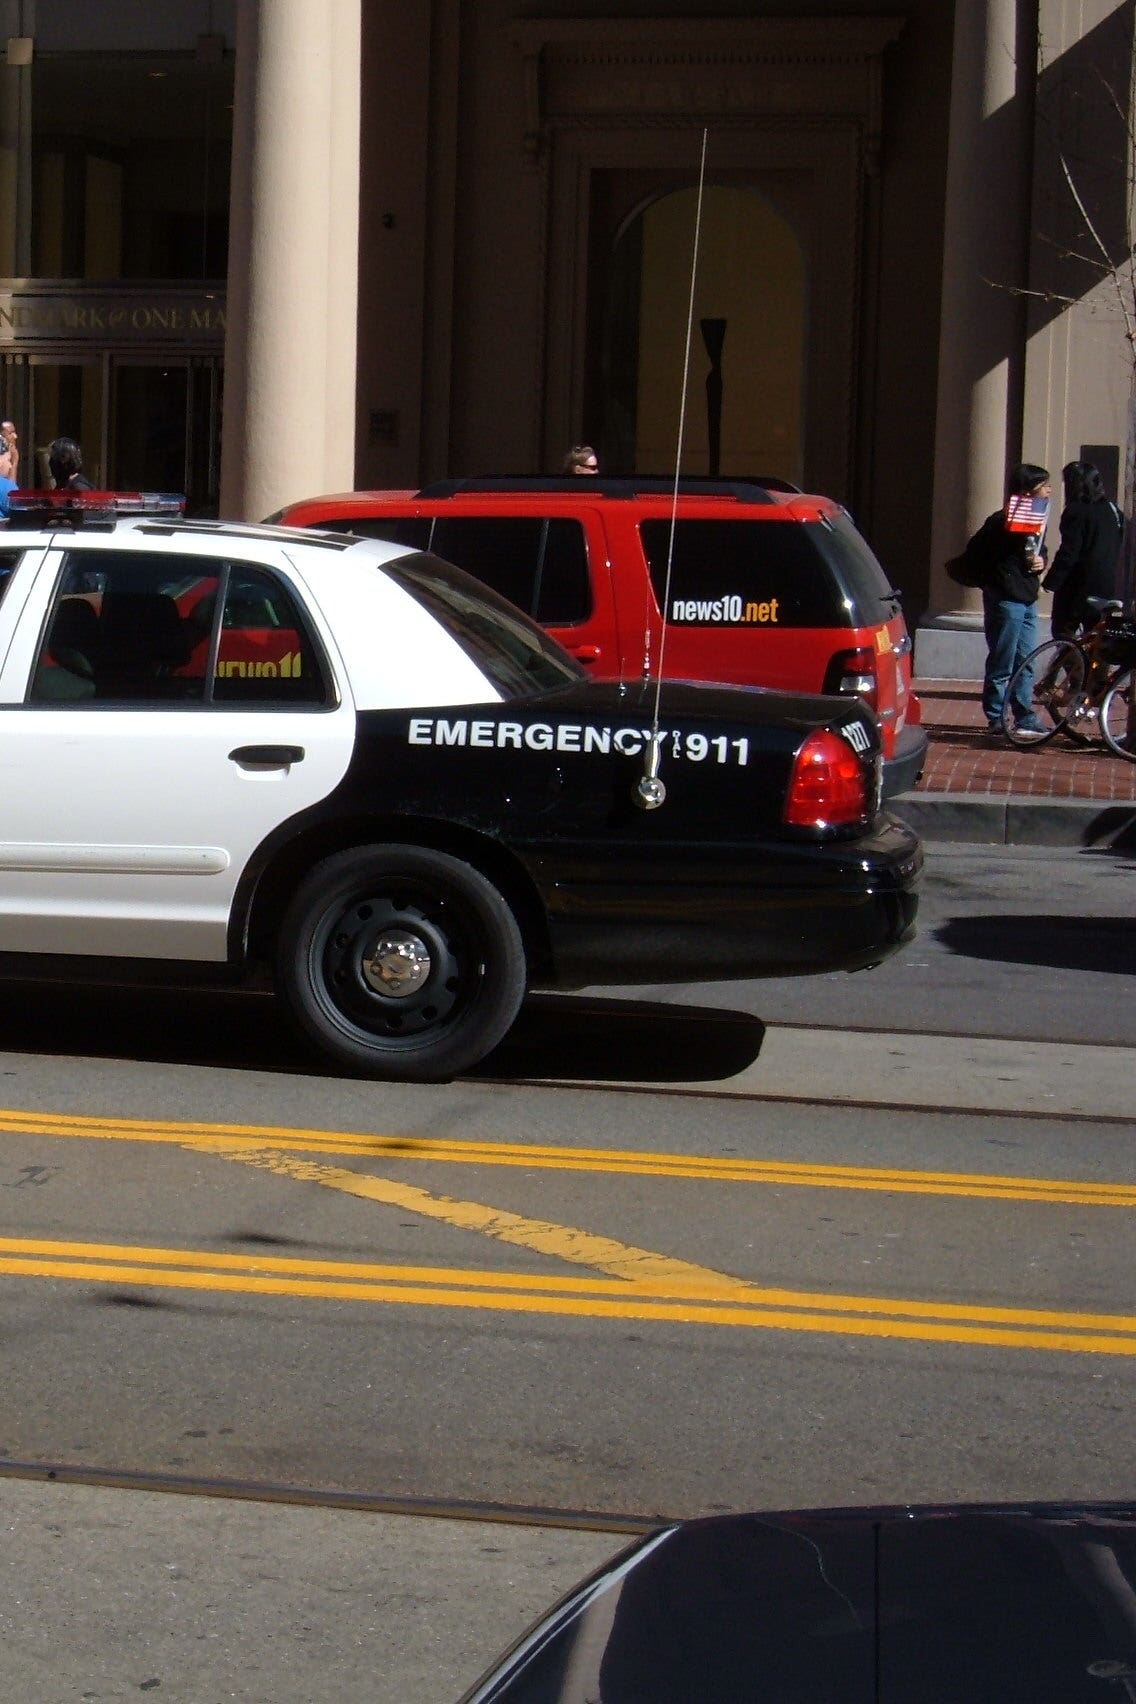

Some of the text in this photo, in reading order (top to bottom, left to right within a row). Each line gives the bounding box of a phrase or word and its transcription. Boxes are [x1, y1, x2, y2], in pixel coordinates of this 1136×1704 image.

[671, 594, 779, 622] news10.net
[408, 718, 668, 757] EMERGENCY
[685, 733, 749, 766] 911
